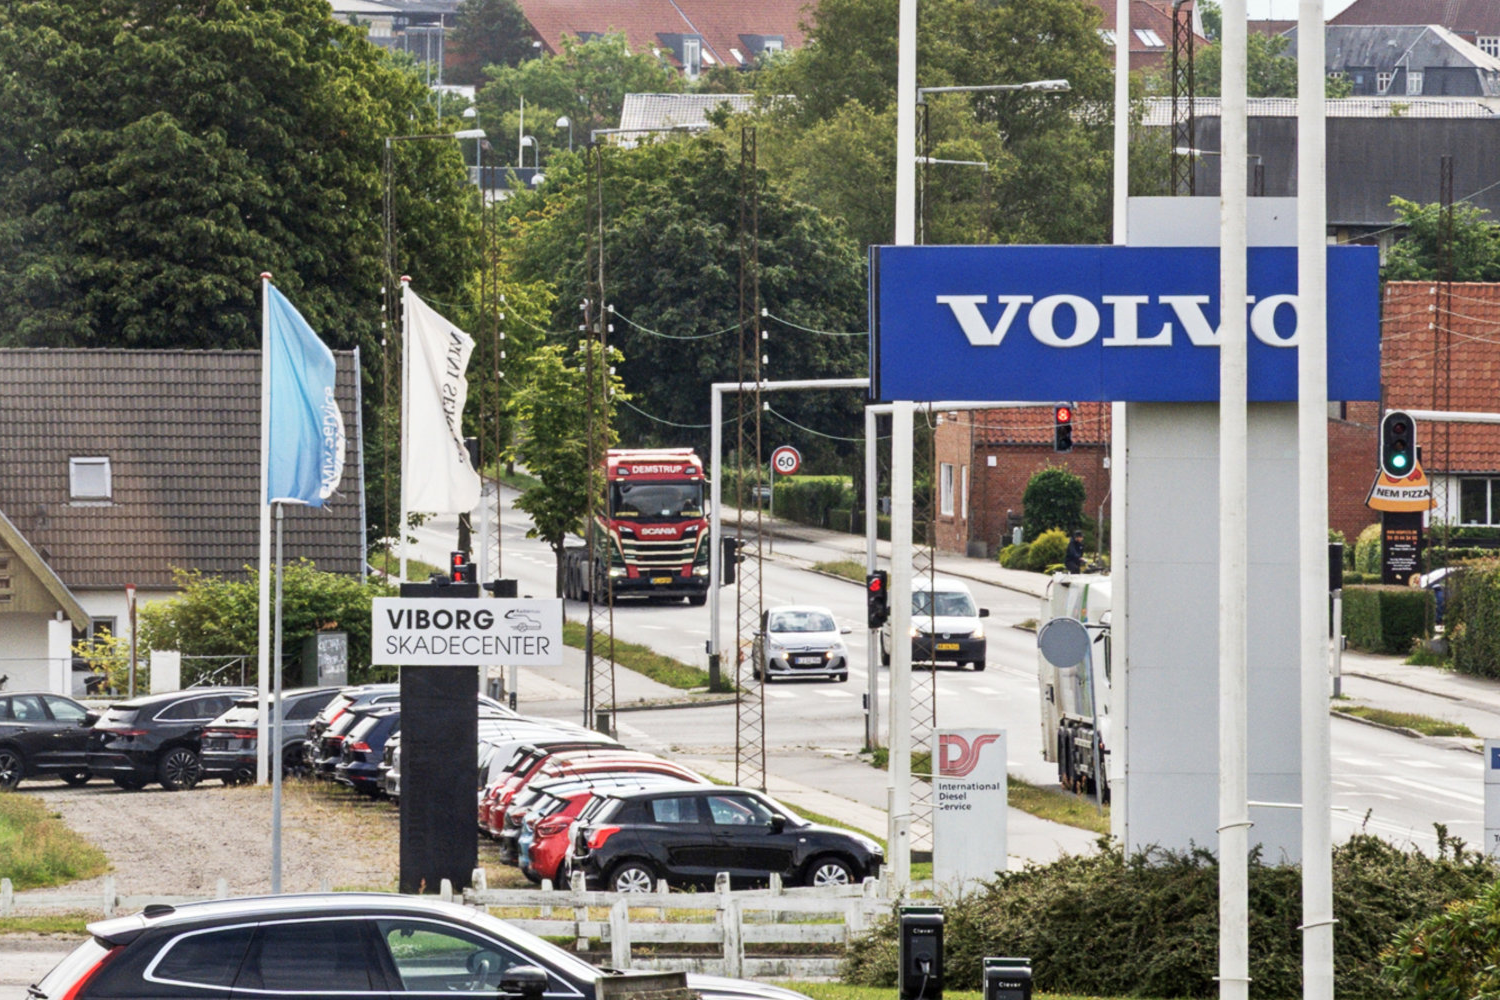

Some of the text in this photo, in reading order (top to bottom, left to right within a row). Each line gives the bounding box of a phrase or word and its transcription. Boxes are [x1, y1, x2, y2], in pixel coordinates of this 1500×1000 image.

[936, 294, 1299, 347] VOLVO
[778, 456, 795, 467] 60
[632, 465, 683, 474] DEMSTRUP
[1377, 487, 1431, 499] NEM PIZZA
[641, 527, 677, 535] SCANIA
[386, 609, 494, 630] VIBORG
[386, 635, 550, 655] SKADECENTER
[939, 782, 1000, 790] International
[939, 792, 967, 800] Diesel
